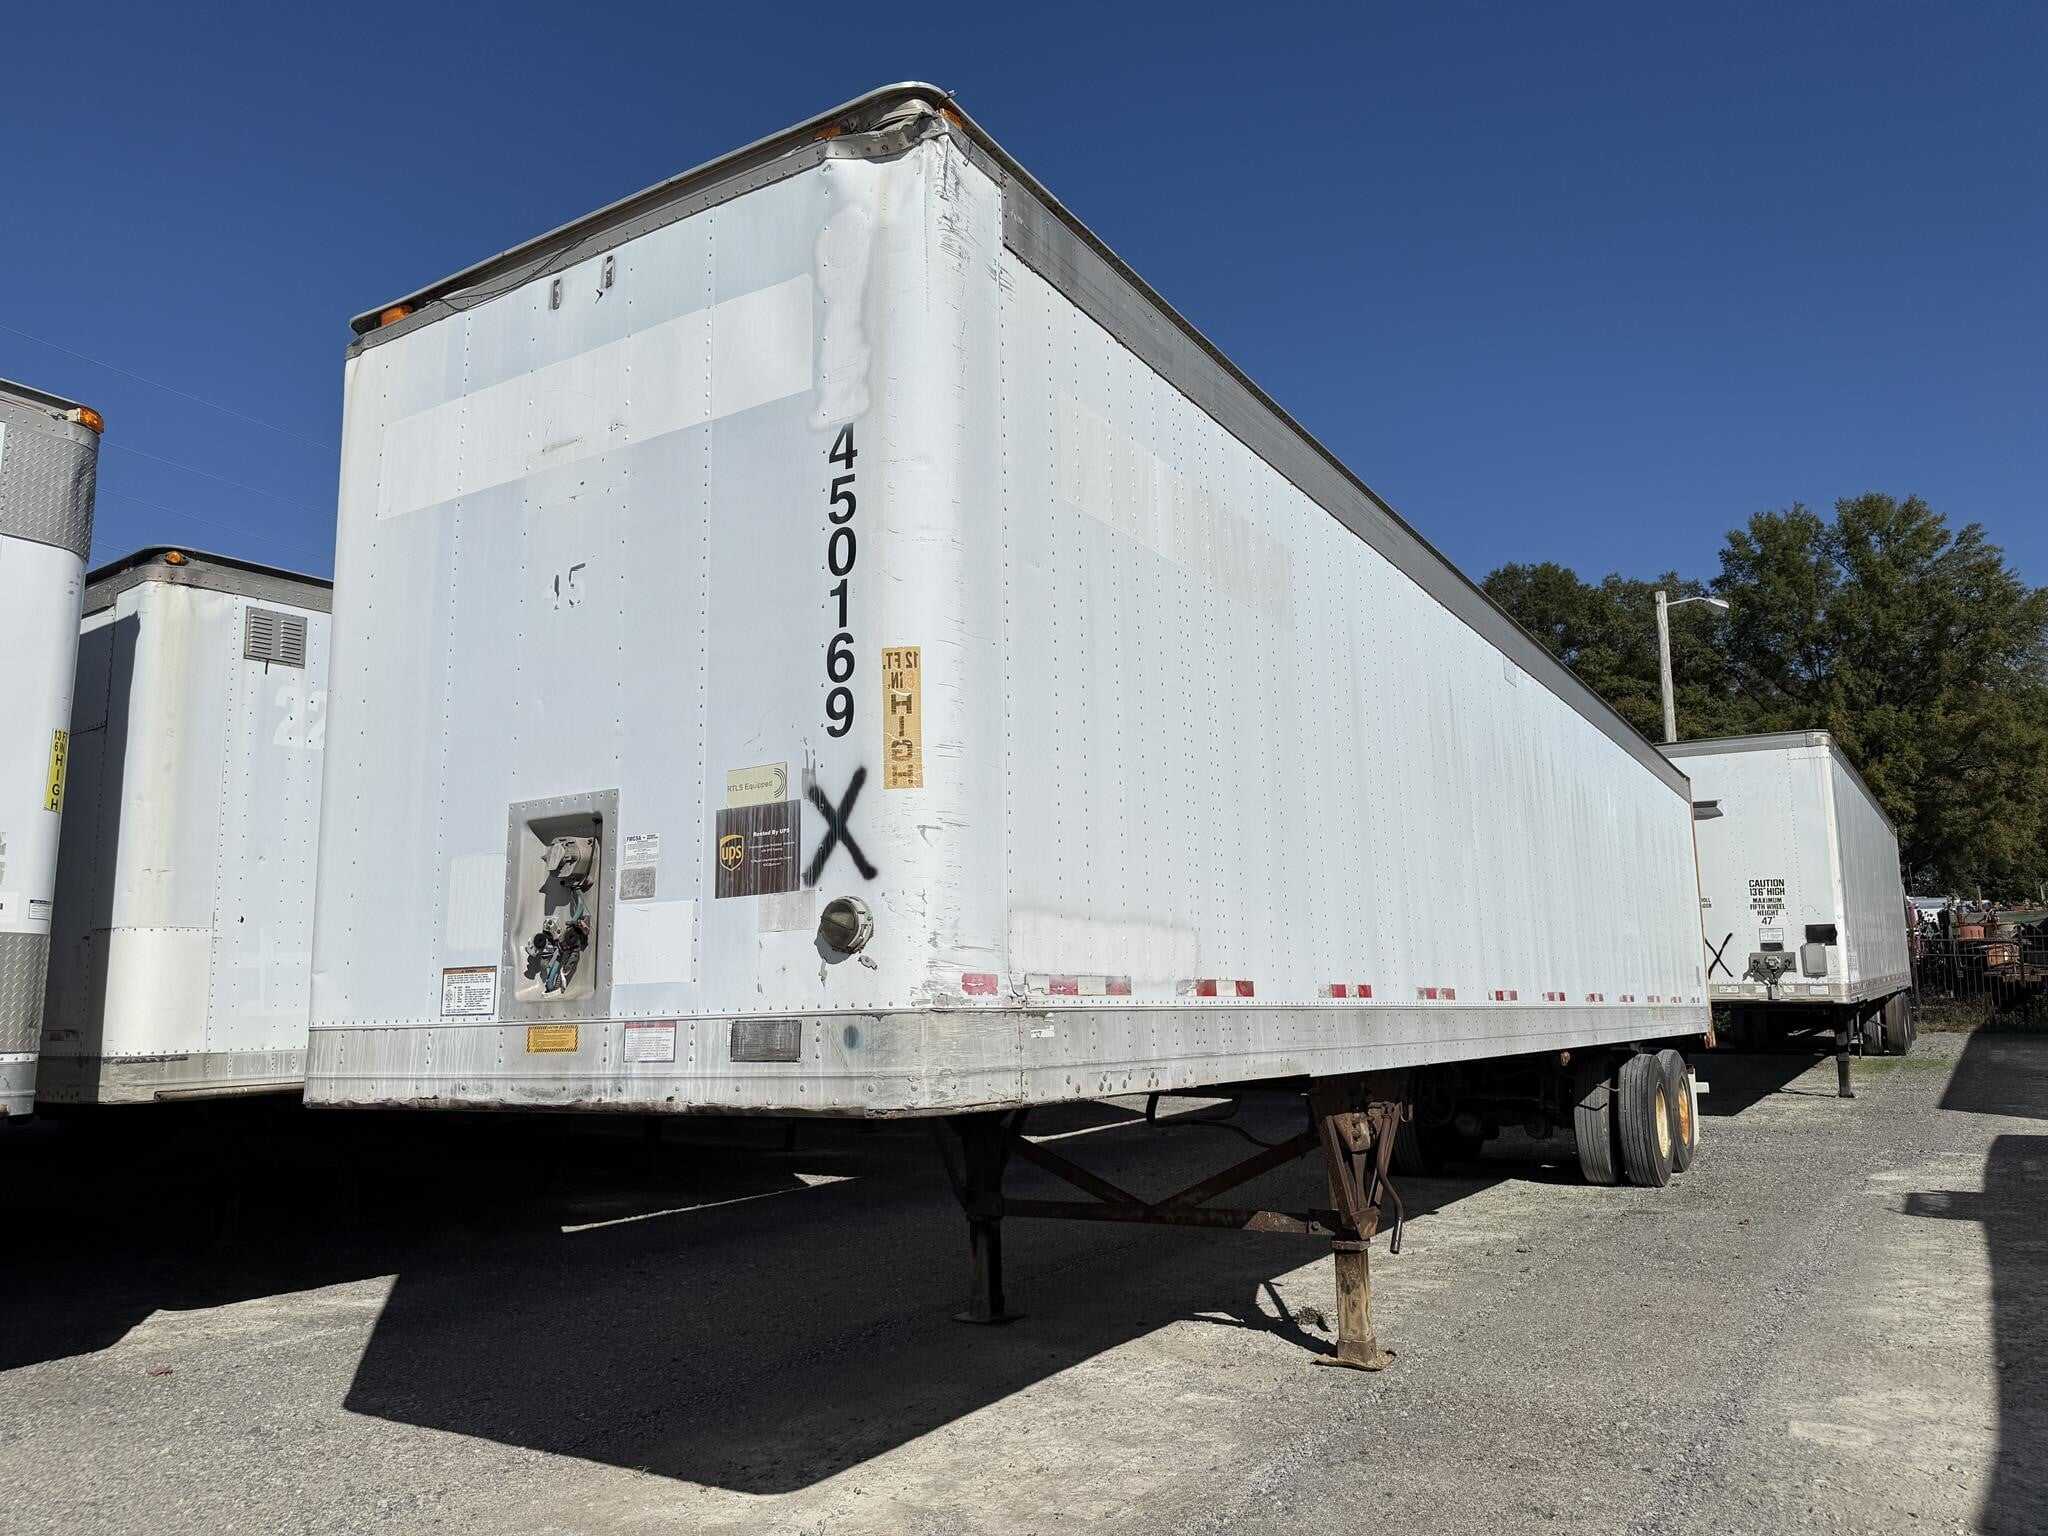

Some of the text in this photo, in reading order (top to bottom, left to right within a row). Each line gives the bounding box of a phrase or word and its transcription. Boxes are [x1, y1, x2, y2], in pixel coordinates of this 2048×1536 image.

[825, 422, 858, 739] 450169
[50, 754, 63, 811] HIGH
[1748, 879, 1785, 888] CAUTION
[1766, 887, 1786, 896] HIGH
